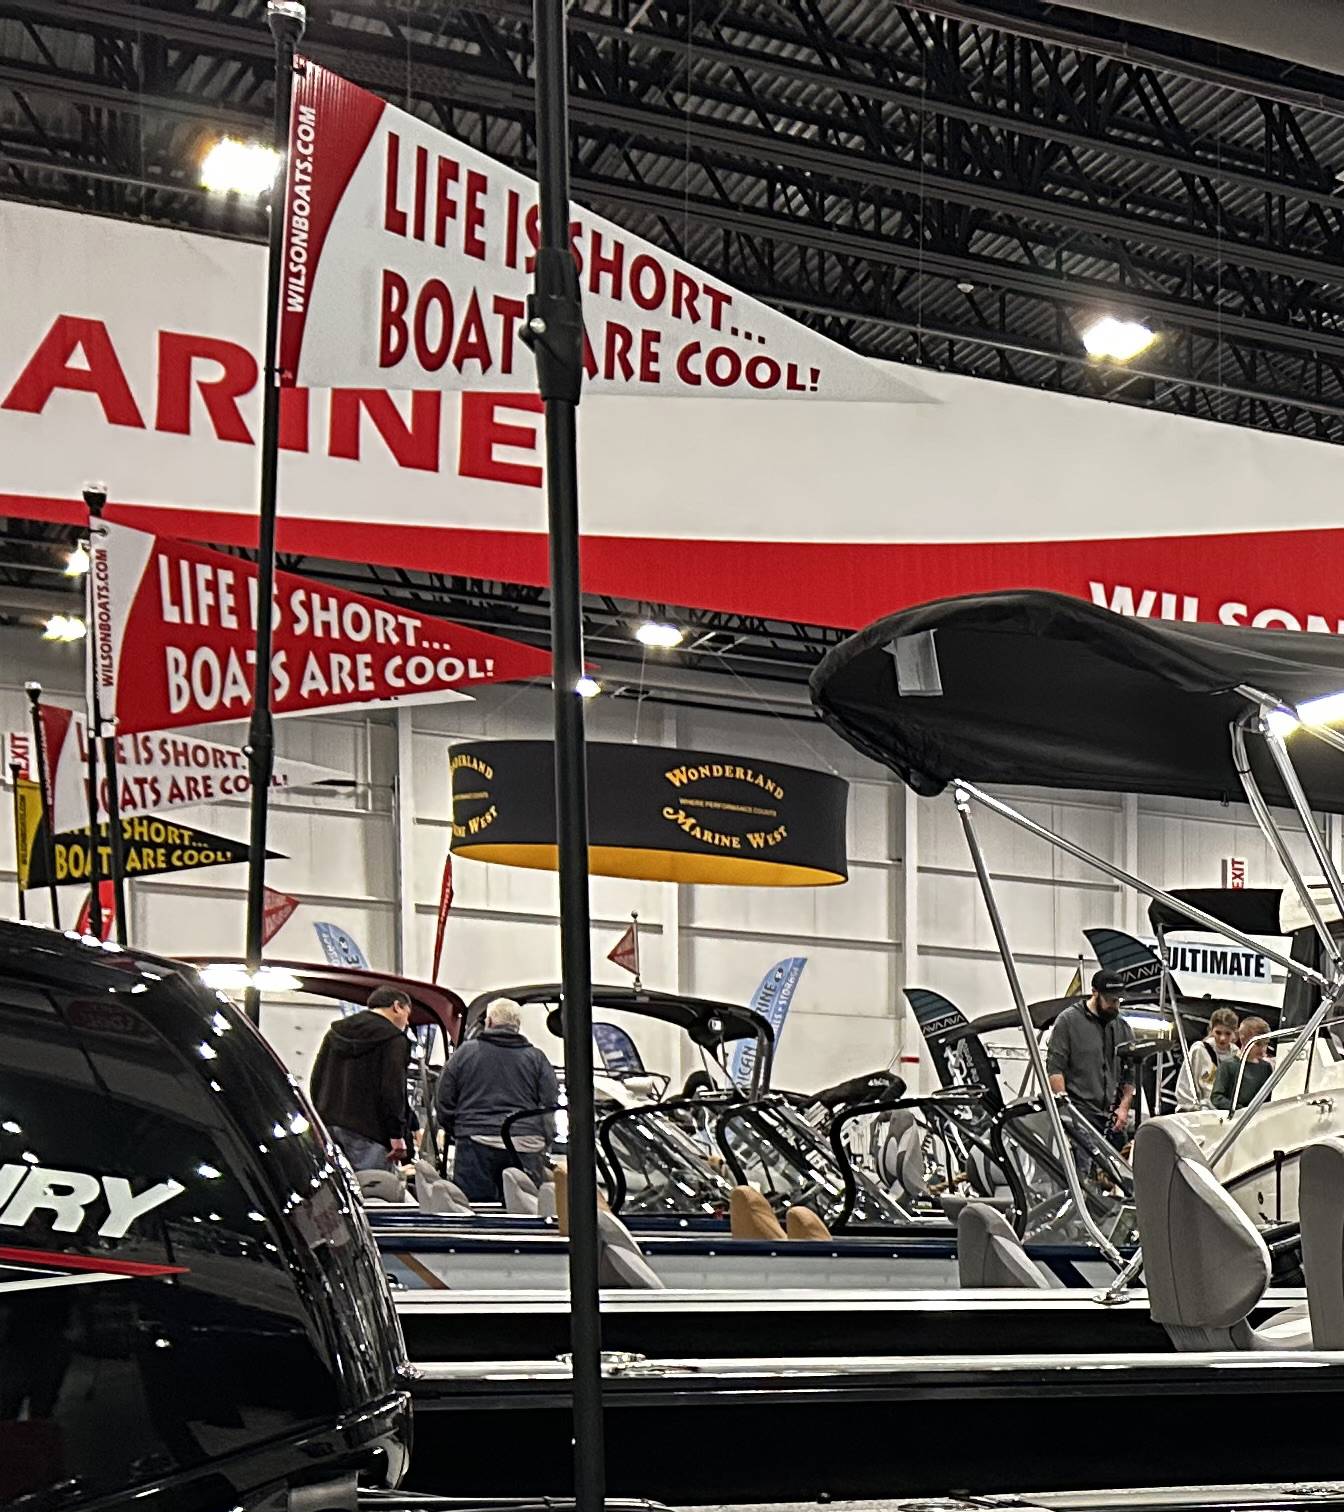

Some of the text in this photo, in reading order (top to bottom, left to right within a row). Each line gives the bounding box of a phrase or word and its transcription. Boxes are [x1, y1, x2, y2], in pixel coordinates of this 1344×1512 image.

[286, 105, 317, 313] WILSONBOATS.COM
[384, 131, 488, 261] LIFE
[379, 268, 525, 376] BOAT
[675, 346, 822, 392] COOL!
[95, 548, 115, 688] WILSONBOATS.COM
[158, 553, 239, 630] LIFE
[289, 588, 452, 651] SHORT...
[165, 645, 495, 714] BOAS ARE COOL!
[133, 732, 155, 766] IS
[167, 774, 215, 805] ARE
[219, 774, 289, 795] COL!
[664, 764, 785, 801] WONDERLAND
[662, 806, 789, 849] MARINE WEST
[55, 843, 233, 880] BOT ARE COOL!
[1231, 858, 1245, 892] EXIT
[1168, 947, 1266, 978] ULTIMATE
